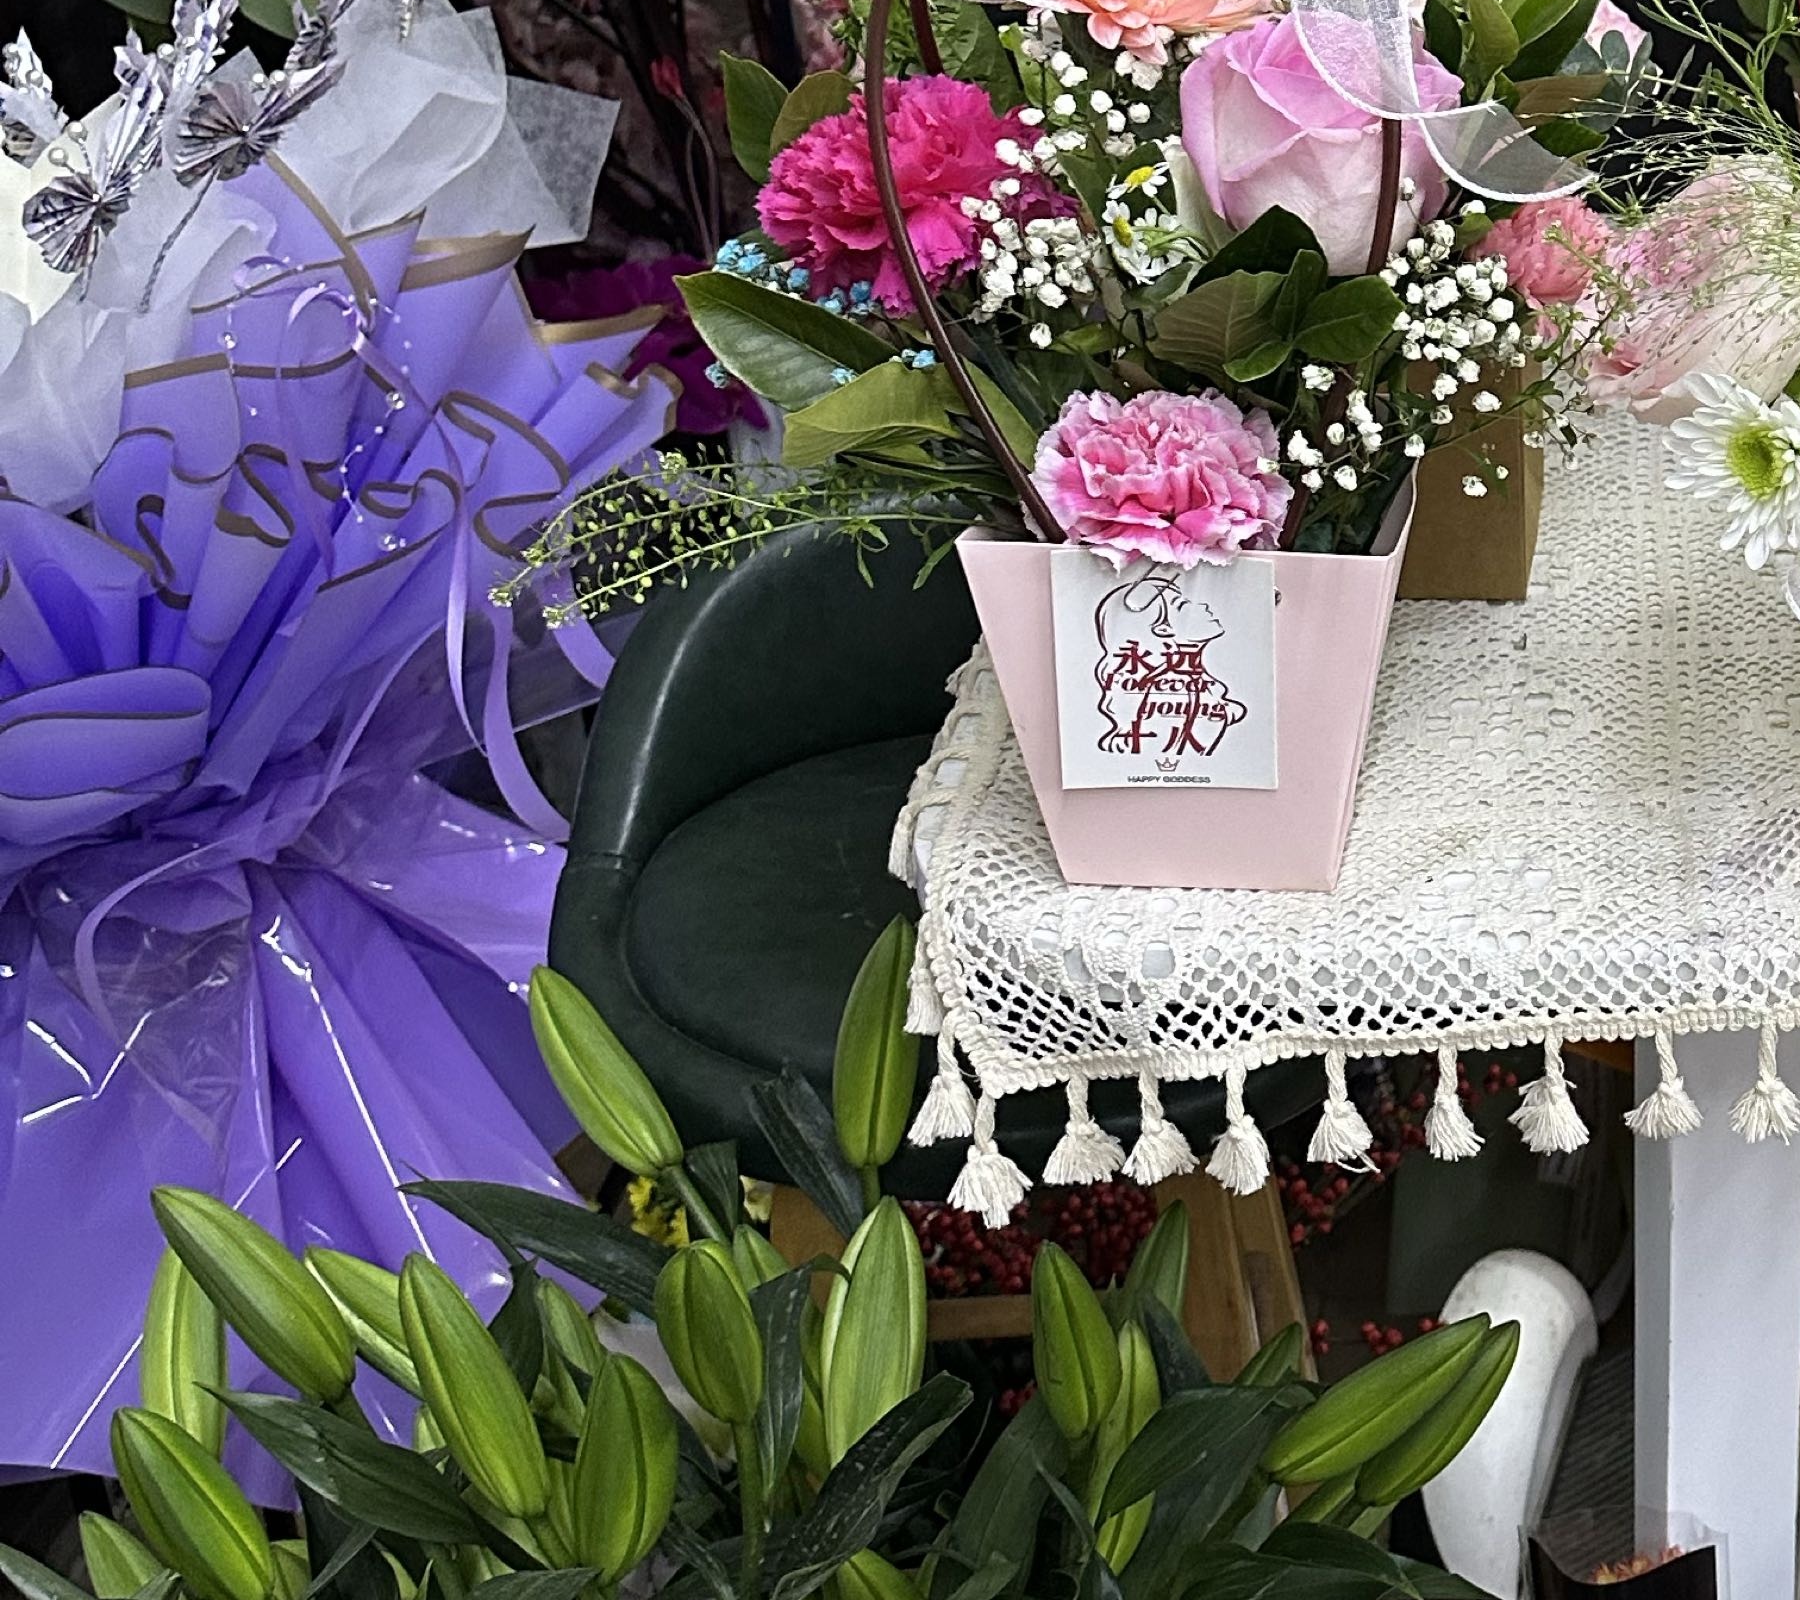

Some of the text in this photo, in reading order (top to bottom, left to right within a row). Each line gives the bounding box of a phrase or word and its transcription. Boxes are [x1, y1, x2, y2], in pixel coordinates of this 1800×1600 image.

[1113, 639, 1203, 676] 永远
[1141, 700, 1228, 722] young
[1127, 775, 1211, 783] HAPPY GODDESS
